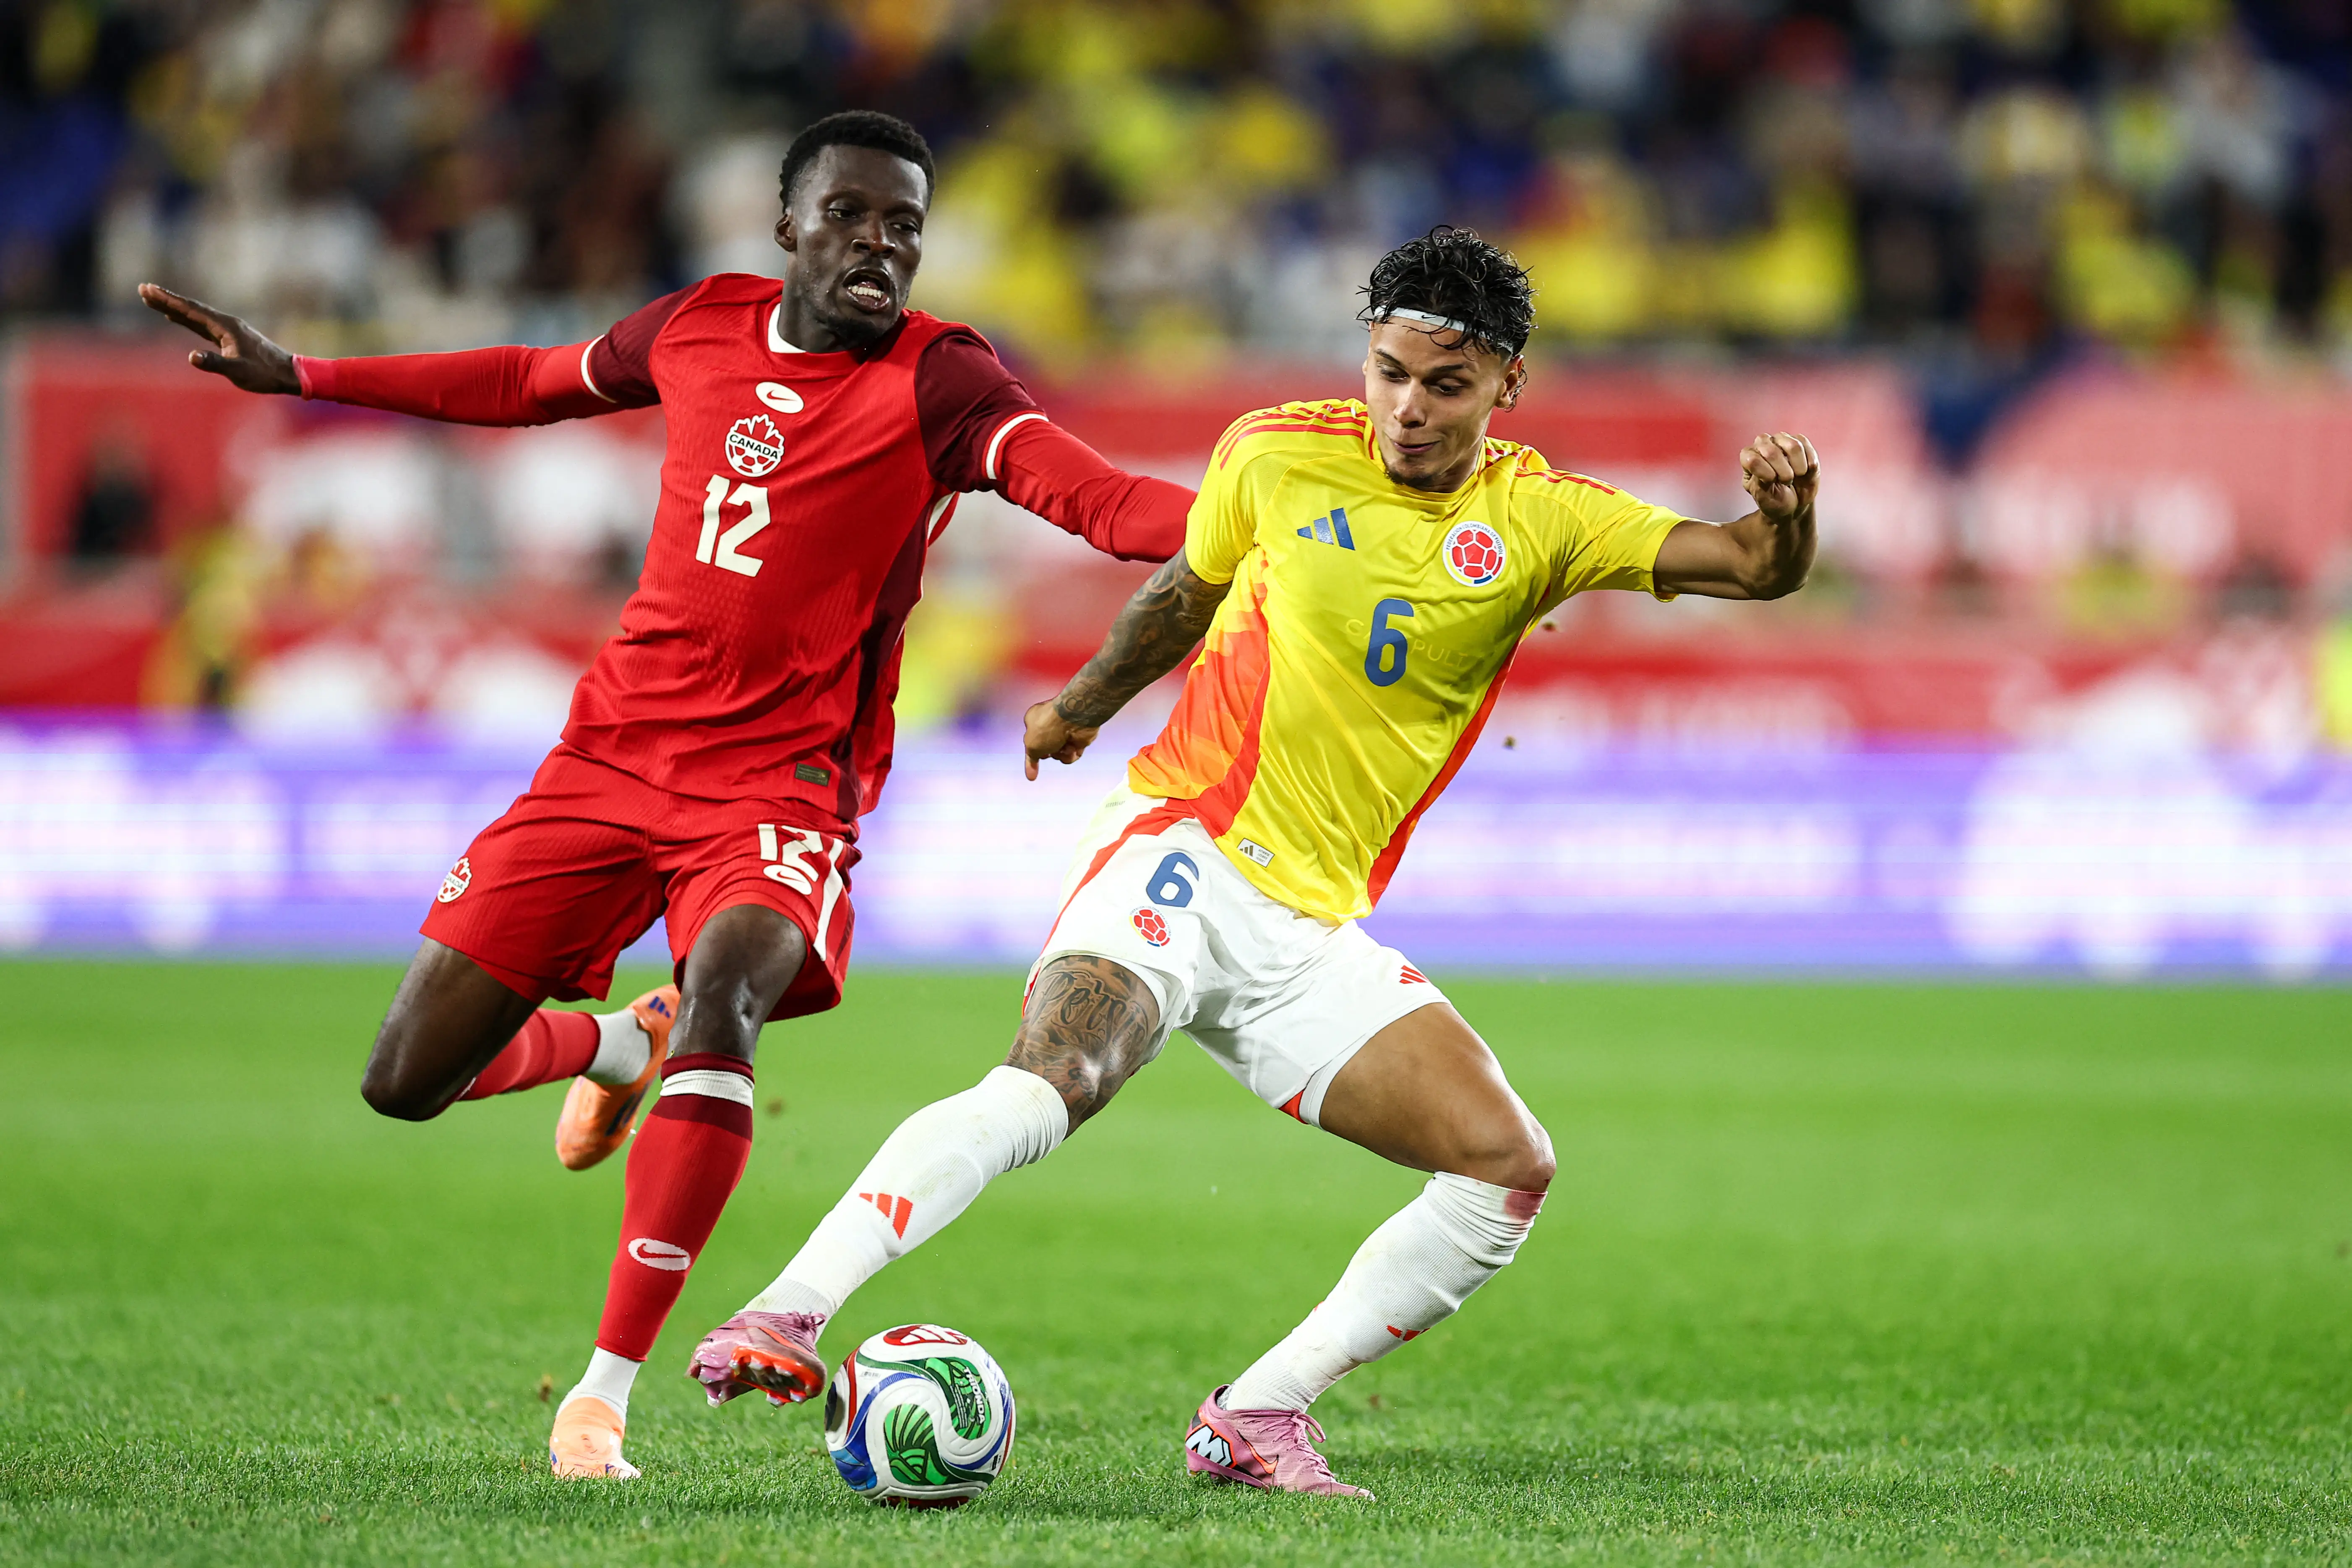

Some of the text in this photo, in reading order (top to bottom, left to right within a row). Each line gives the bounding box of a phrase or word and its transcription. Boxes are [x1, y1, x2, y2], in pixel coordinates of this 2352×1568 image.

[730, 434, 778, 459] CANADA
[695, 474, 771, 577] 12
[1364, 598, 1414, 687] 6
[757, 823, 824, 882] 12
[1146, 852, 1199, 908] 6
[964, 1366, 986, 1424] TRIONDA
